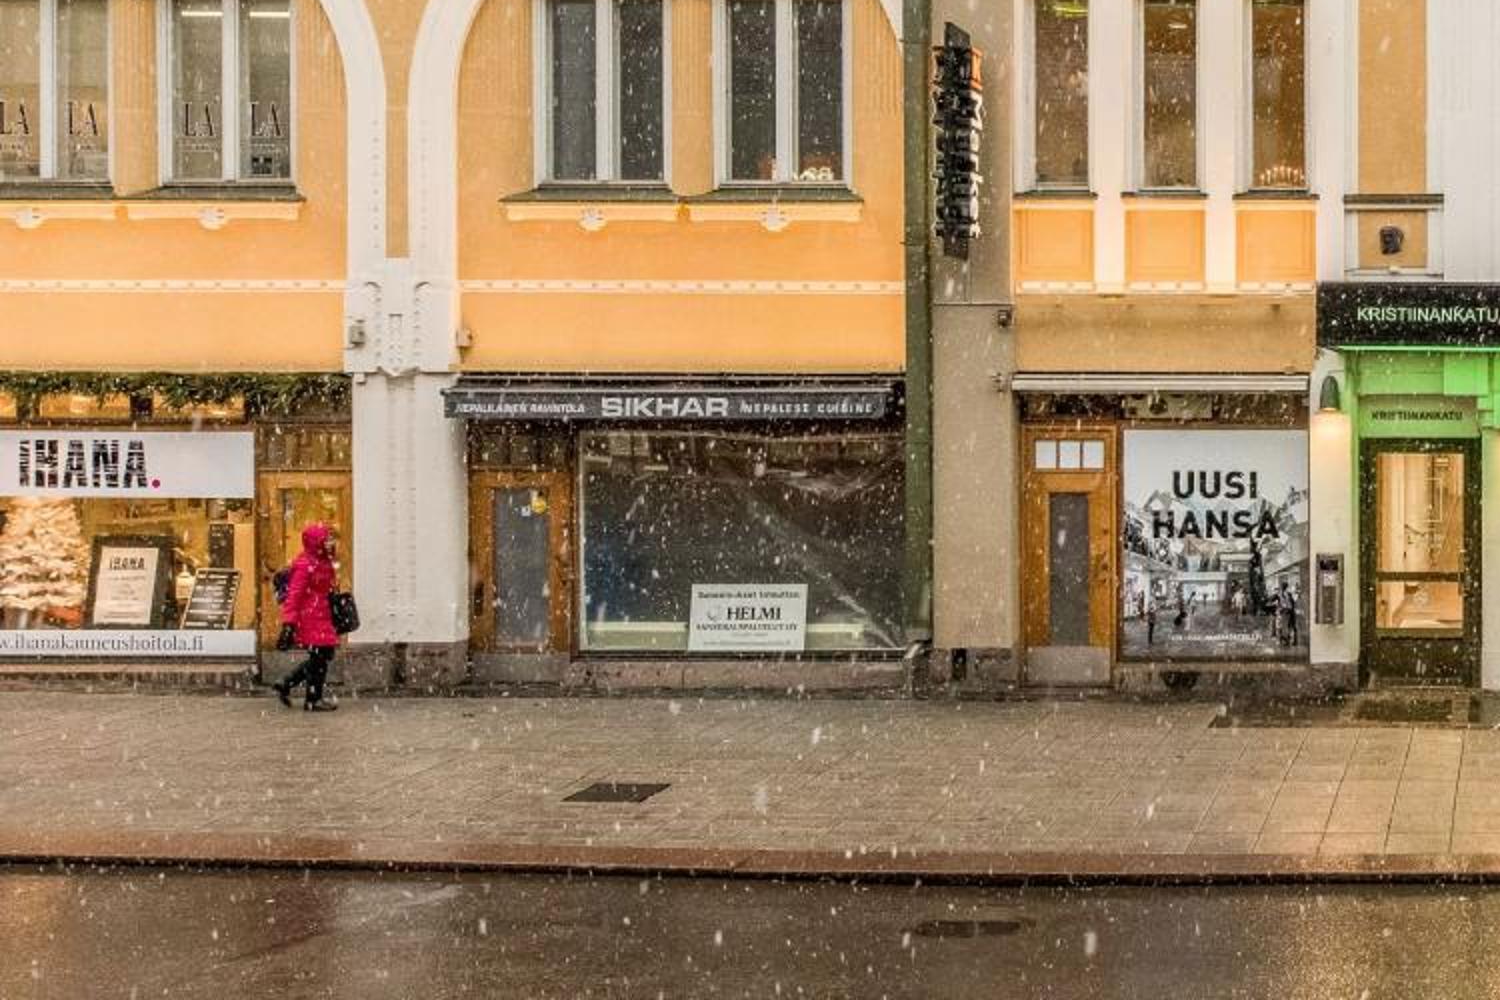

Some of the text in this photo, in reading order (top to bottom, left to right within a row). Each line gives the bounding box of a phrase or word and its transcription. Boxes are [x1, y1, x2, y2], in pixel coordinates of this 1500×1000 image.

[1357, 307, 1499, 322] KRISTIINANKATU
[601, 396, 729, 417] SIKHAR
[739, 401, 810, 413] NEPALESE
[817, 402, 873, 413] CUISINE
[1173, 470, 1258, 499] UUSI
[1152, 509, 1280, 539] HANSA
[727, 607, 781, 620] HELMI
